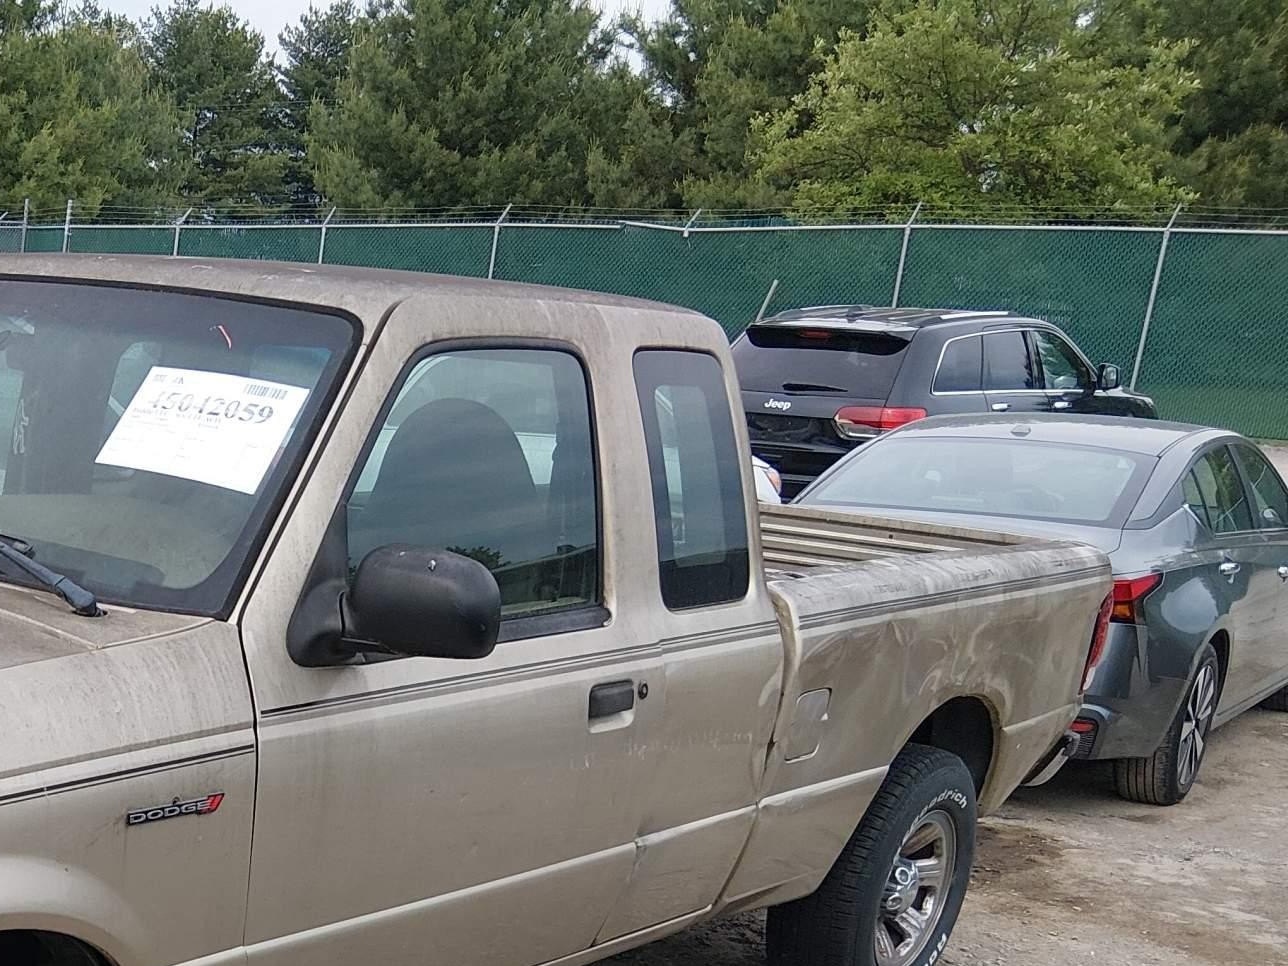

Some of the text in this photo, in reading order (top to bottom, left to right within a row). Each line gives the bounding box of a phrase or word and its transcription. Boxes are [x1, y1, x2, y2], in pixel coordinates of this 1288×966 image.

[148, 391, 274, 424] 45042059
[764, 398, 791, 411] Jeep
[129, 801, 211, 824] DODGE
